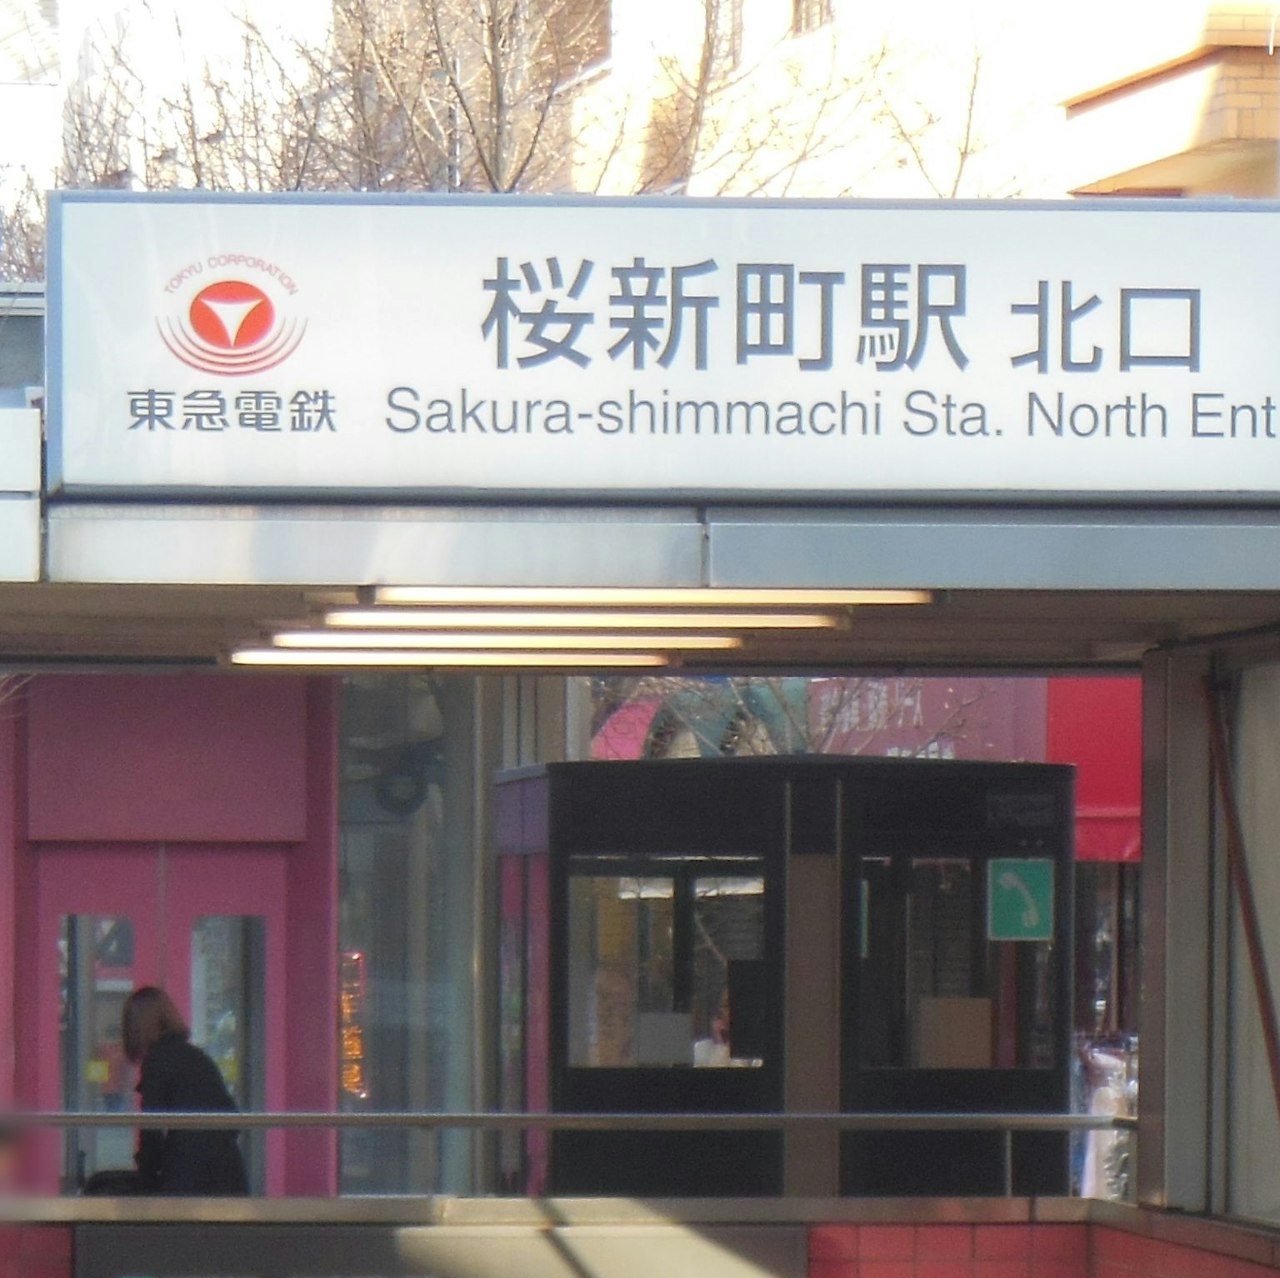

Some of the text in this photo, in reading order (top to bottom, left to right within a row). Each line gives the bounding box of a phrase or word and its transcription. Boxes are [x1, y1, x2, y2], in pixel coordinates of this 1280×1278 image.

[164, 254, 299, 296] TOKYU CORPORATION
[480, 255, 1202, 374] 桜新町駅 北口
[127, 389, 337, 433] 東急電鉄
[385, 386, 880, 436] Sakura-shimmachi
[903, 390, 1003, 437] Sta.
[1026, 391, 1167, 438] North
